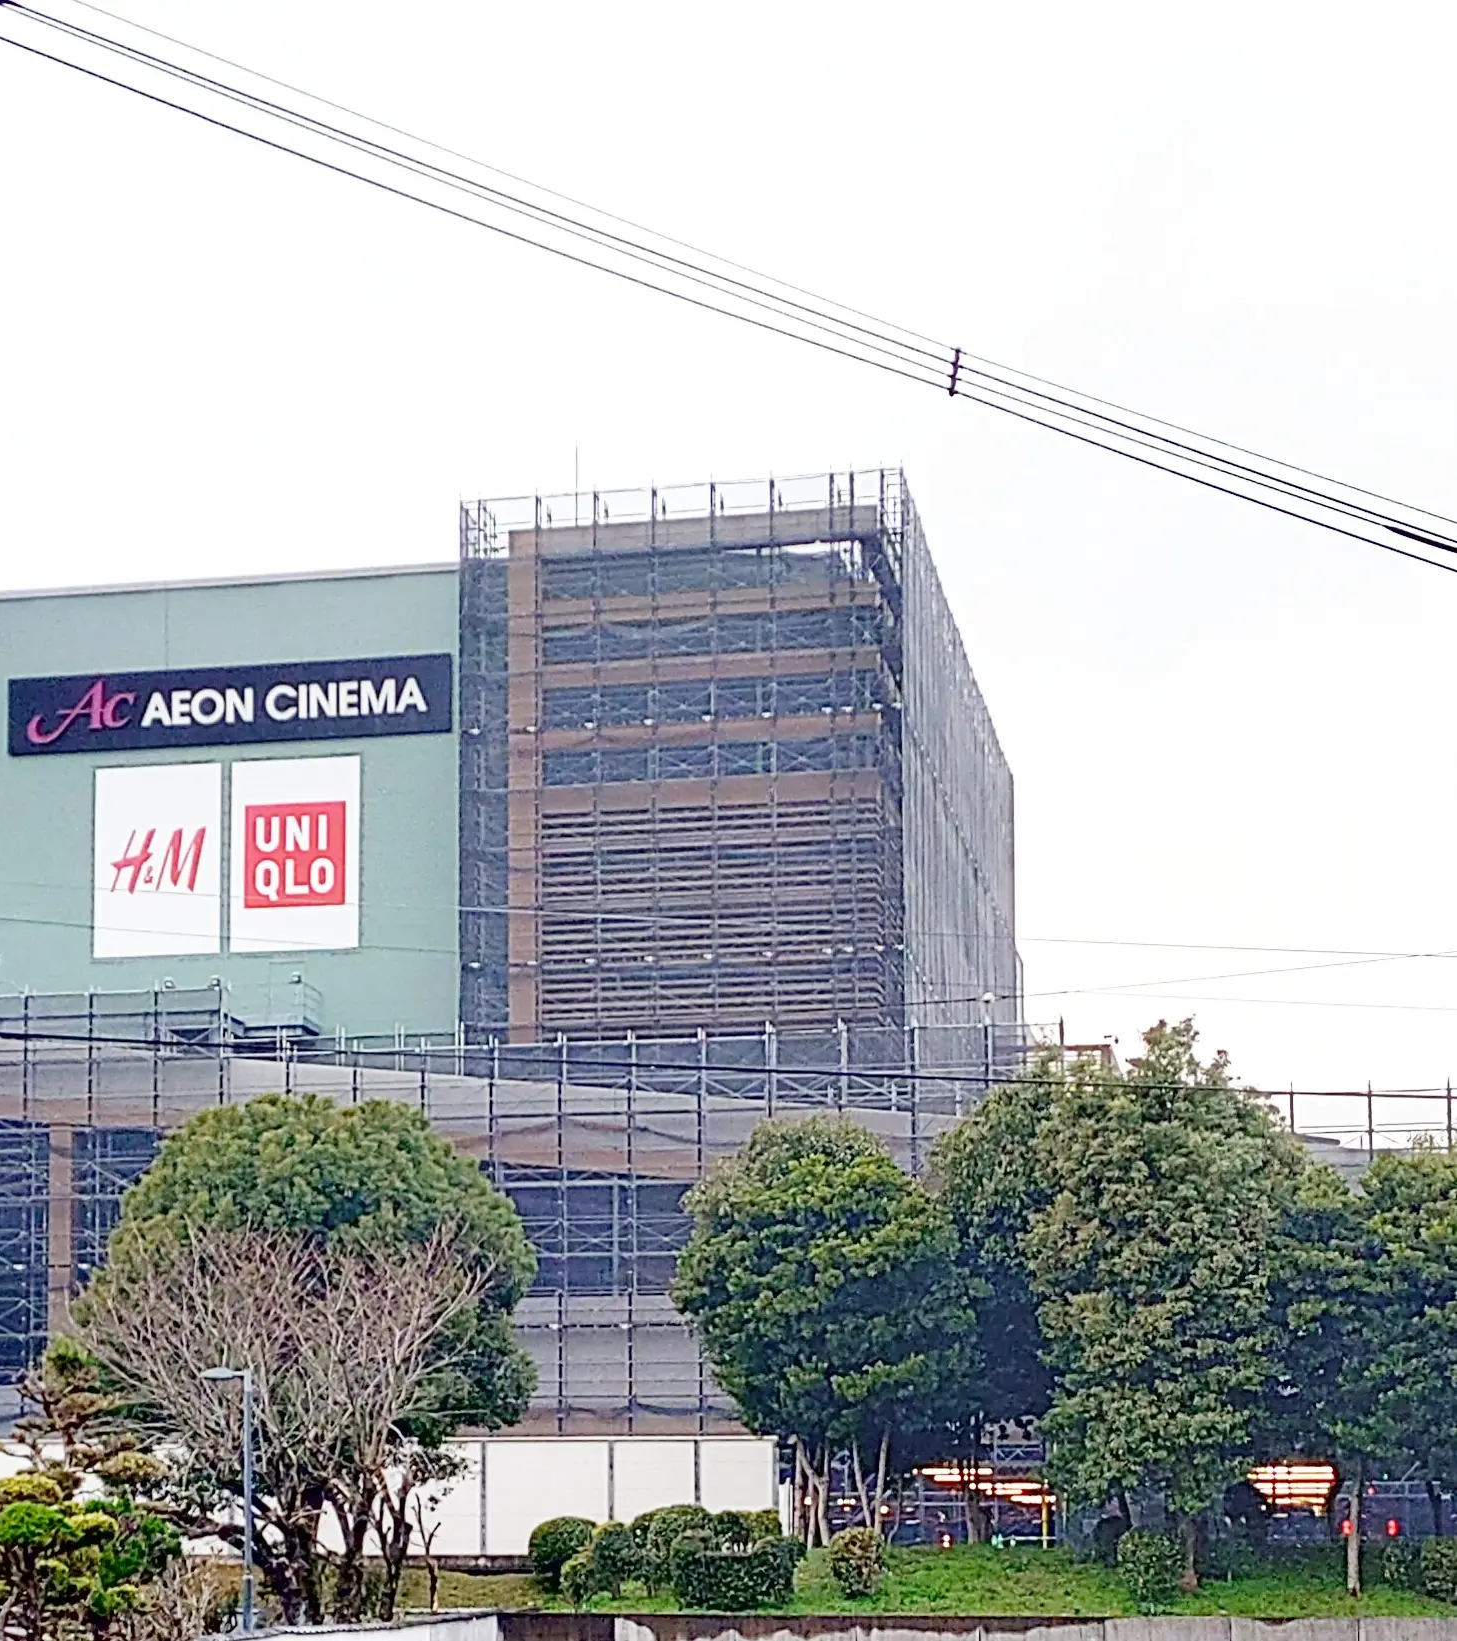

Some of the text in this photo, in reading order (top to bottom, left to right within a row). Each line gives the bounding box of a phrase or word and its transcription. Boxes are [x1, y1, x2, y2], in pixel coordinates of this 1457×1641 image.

[141, 686, 254, 728] AEON
[265, 677, 428, 721] CINEMA
[254, 813, 329, 852] UNI
[110, 825, 208, 895] H&M
[254, 857, 336, 901] QLO
